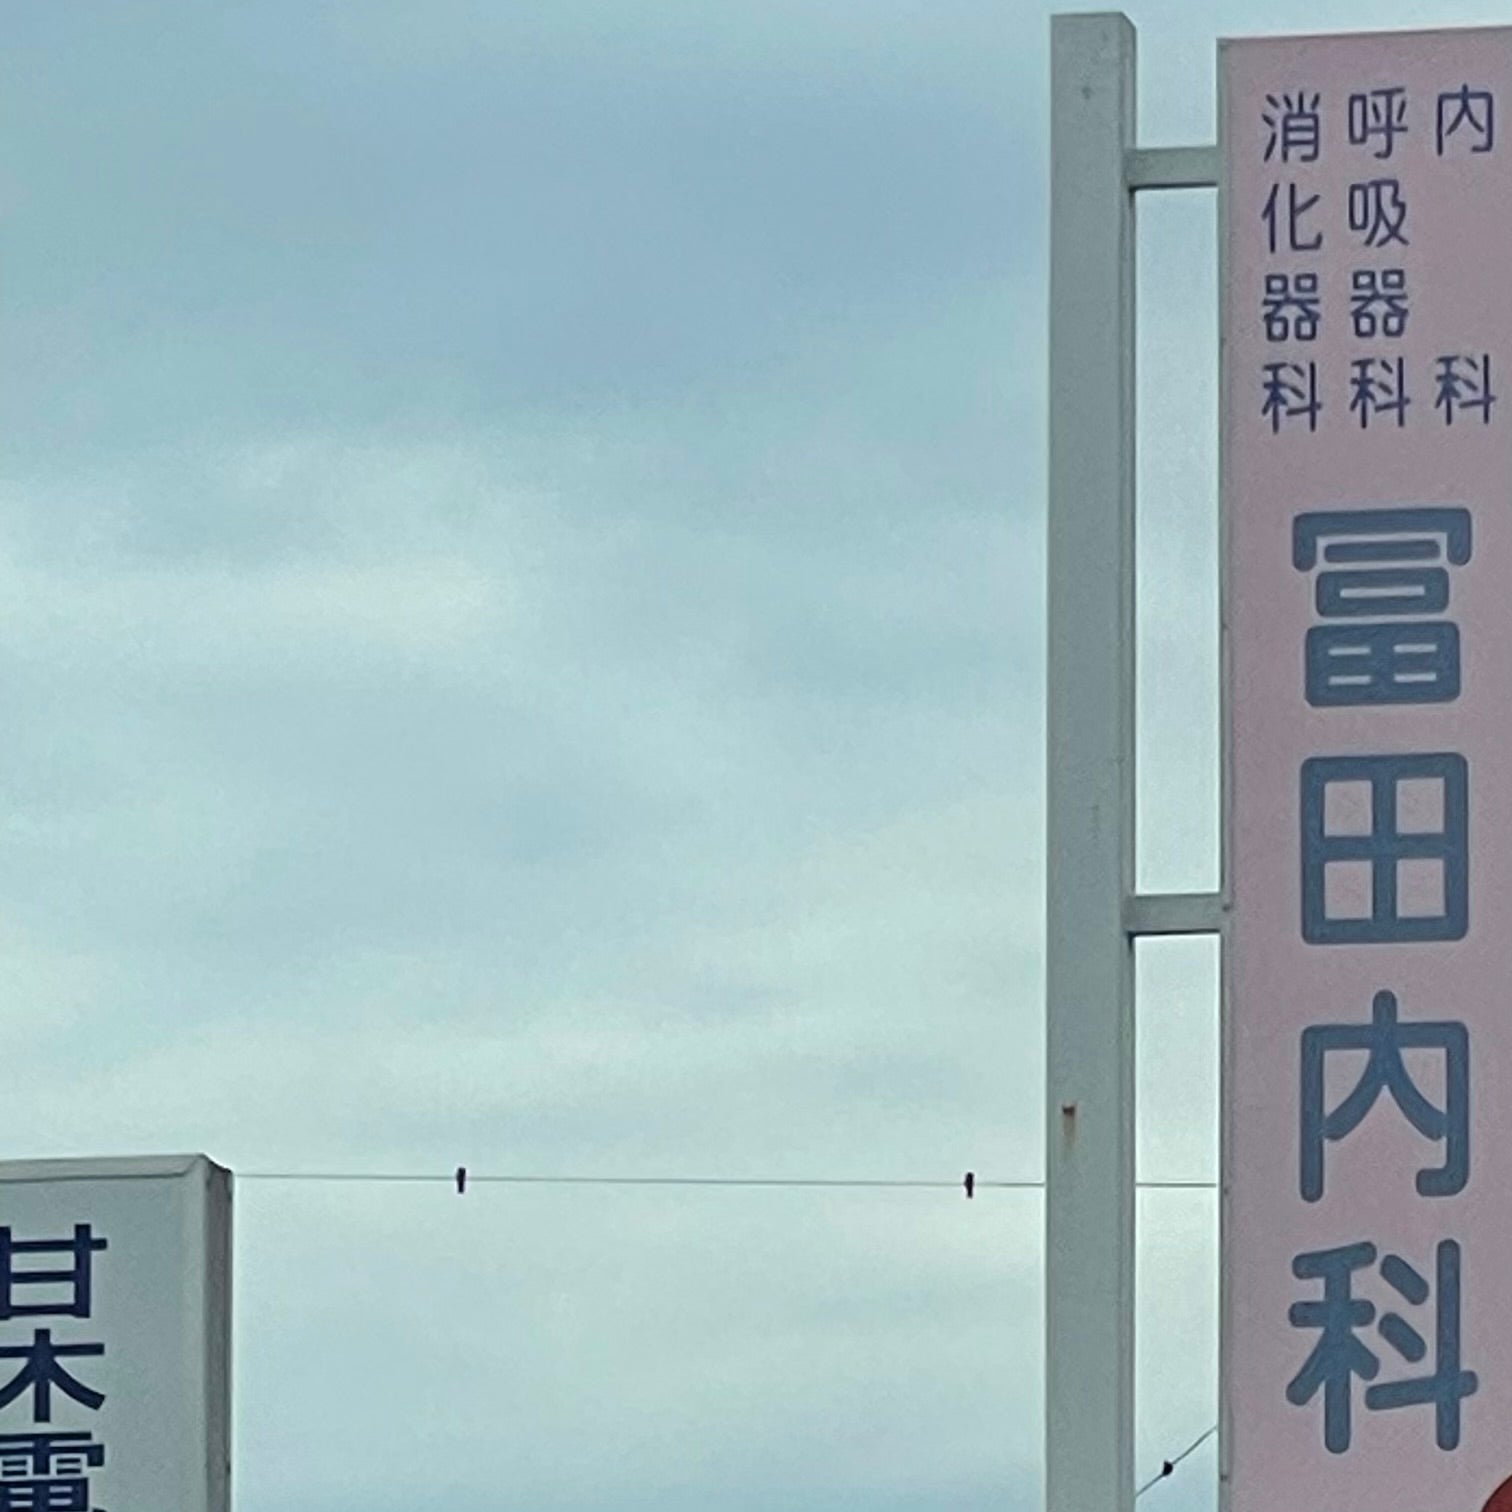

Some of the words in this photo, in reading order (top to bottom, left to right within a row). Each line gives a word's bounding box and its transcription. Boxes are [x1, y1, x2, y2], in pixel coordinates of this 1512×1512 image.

[1261, 90, 1324, 435] 消化器科
[1347, 86, 1411, 429] 呼吸器科
[1434, 83, 1497, 425] 内科
[1285, 507, 1479, 1455] 冨田内科
